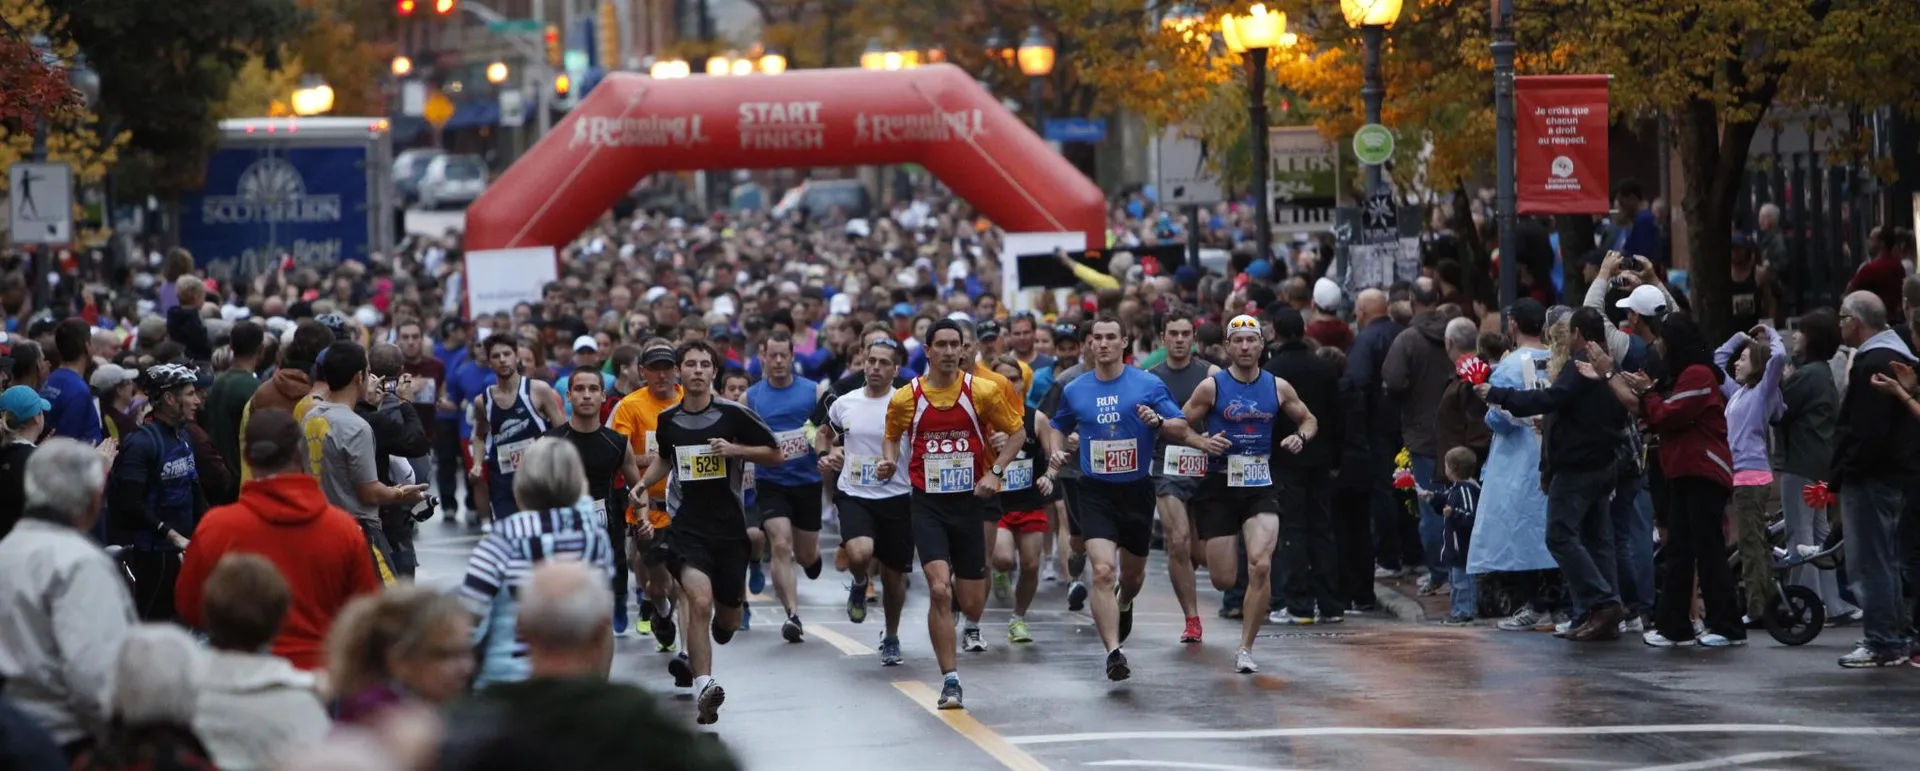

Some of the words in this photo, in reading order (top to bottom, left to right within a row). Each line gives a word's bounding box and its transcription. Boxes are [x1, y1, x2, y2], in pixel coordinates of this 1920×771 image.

[739, 102, 822, 122] START
[1535, 106, 1546, 116] Je
[1547, 106, 1570, 115] crois
[1572, 106, 1589, 117] que
[1546, 116, 1579, 126] chacun
[1548, 127, 1554, 135] a
[1555, 126, 1577, 135] droit
[740, 130, 823, 150] FINISH
[1538, 137, 1549, 145] au
[1551, 136, 1587, 147] respect.
[1096, 395, 1119, 407] RUN
[782, 438, 806, 456] 2529
[696, 456, 719, 473] 529
[1108, 449, 1134, 468] 2167
[1180, 456, 1206, 471] 2031
[942, 467, 971, 487] 1476
[1008, 468, 1031, 486] 1626
[1244, 464, 1269, 481] 3063
